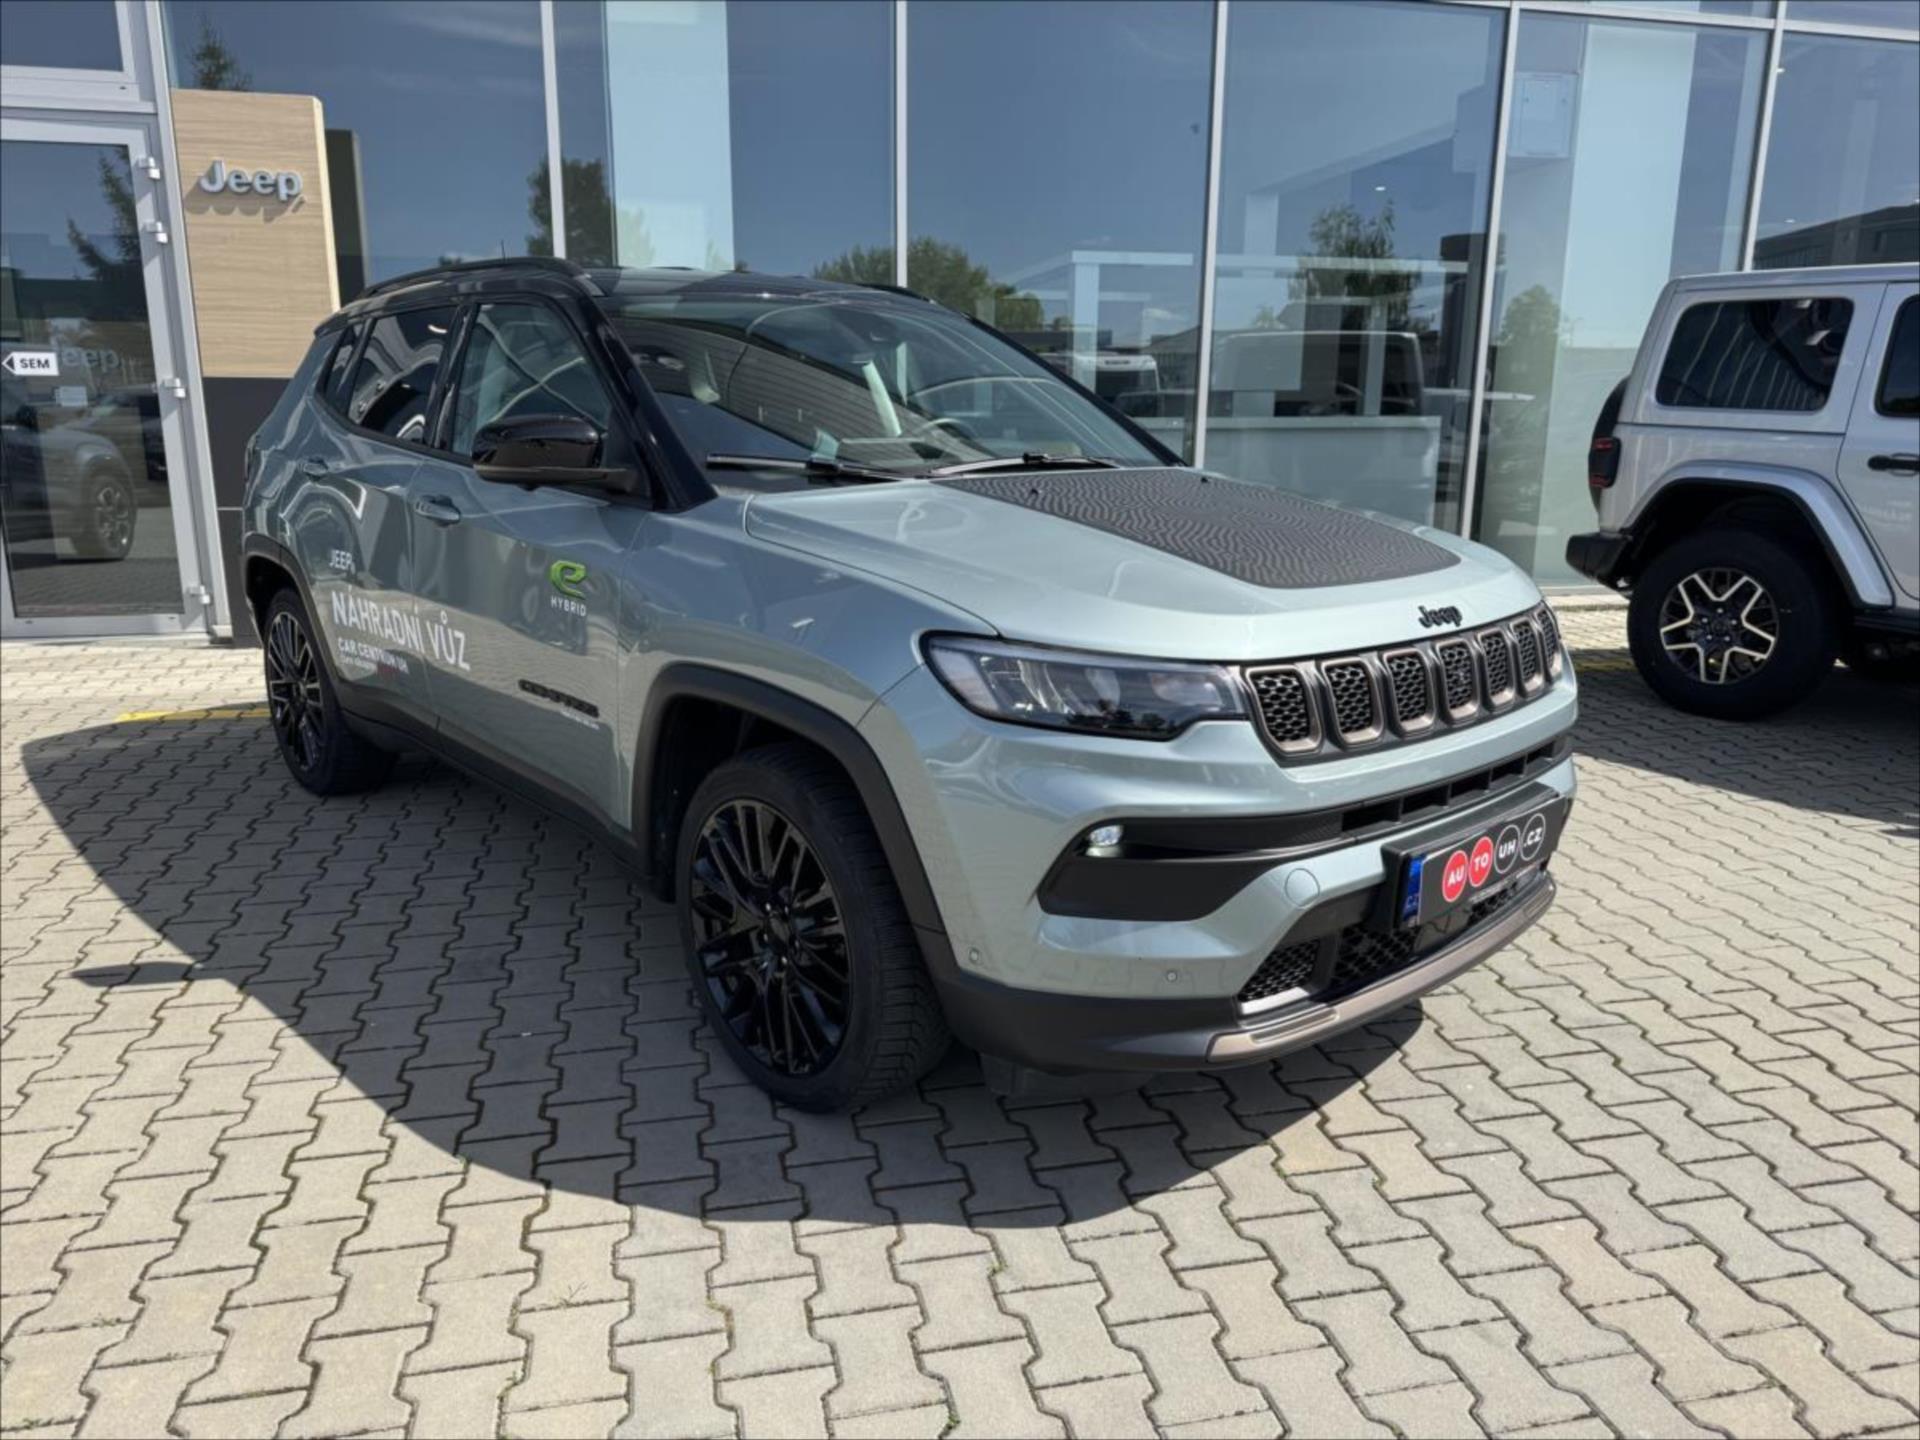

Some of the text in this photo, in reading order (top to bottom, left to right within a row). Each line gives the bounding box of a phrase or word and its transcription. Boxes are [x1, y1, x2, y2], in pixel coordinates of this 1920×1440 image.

[199, 159, 304, 200] Jeep
[19, 358, 51, 369] SEM
[551, 596, 587, 617] HYBRID
[1418, 605, 1463, 628] Jeep
[331, 585, 471, 672] NÁHRADNÍ VŮZ
[1447, 868, 1465, 888] AU
[1473, 852, 1490, 873] TO
[1498, 839, 1517, 859] UH
